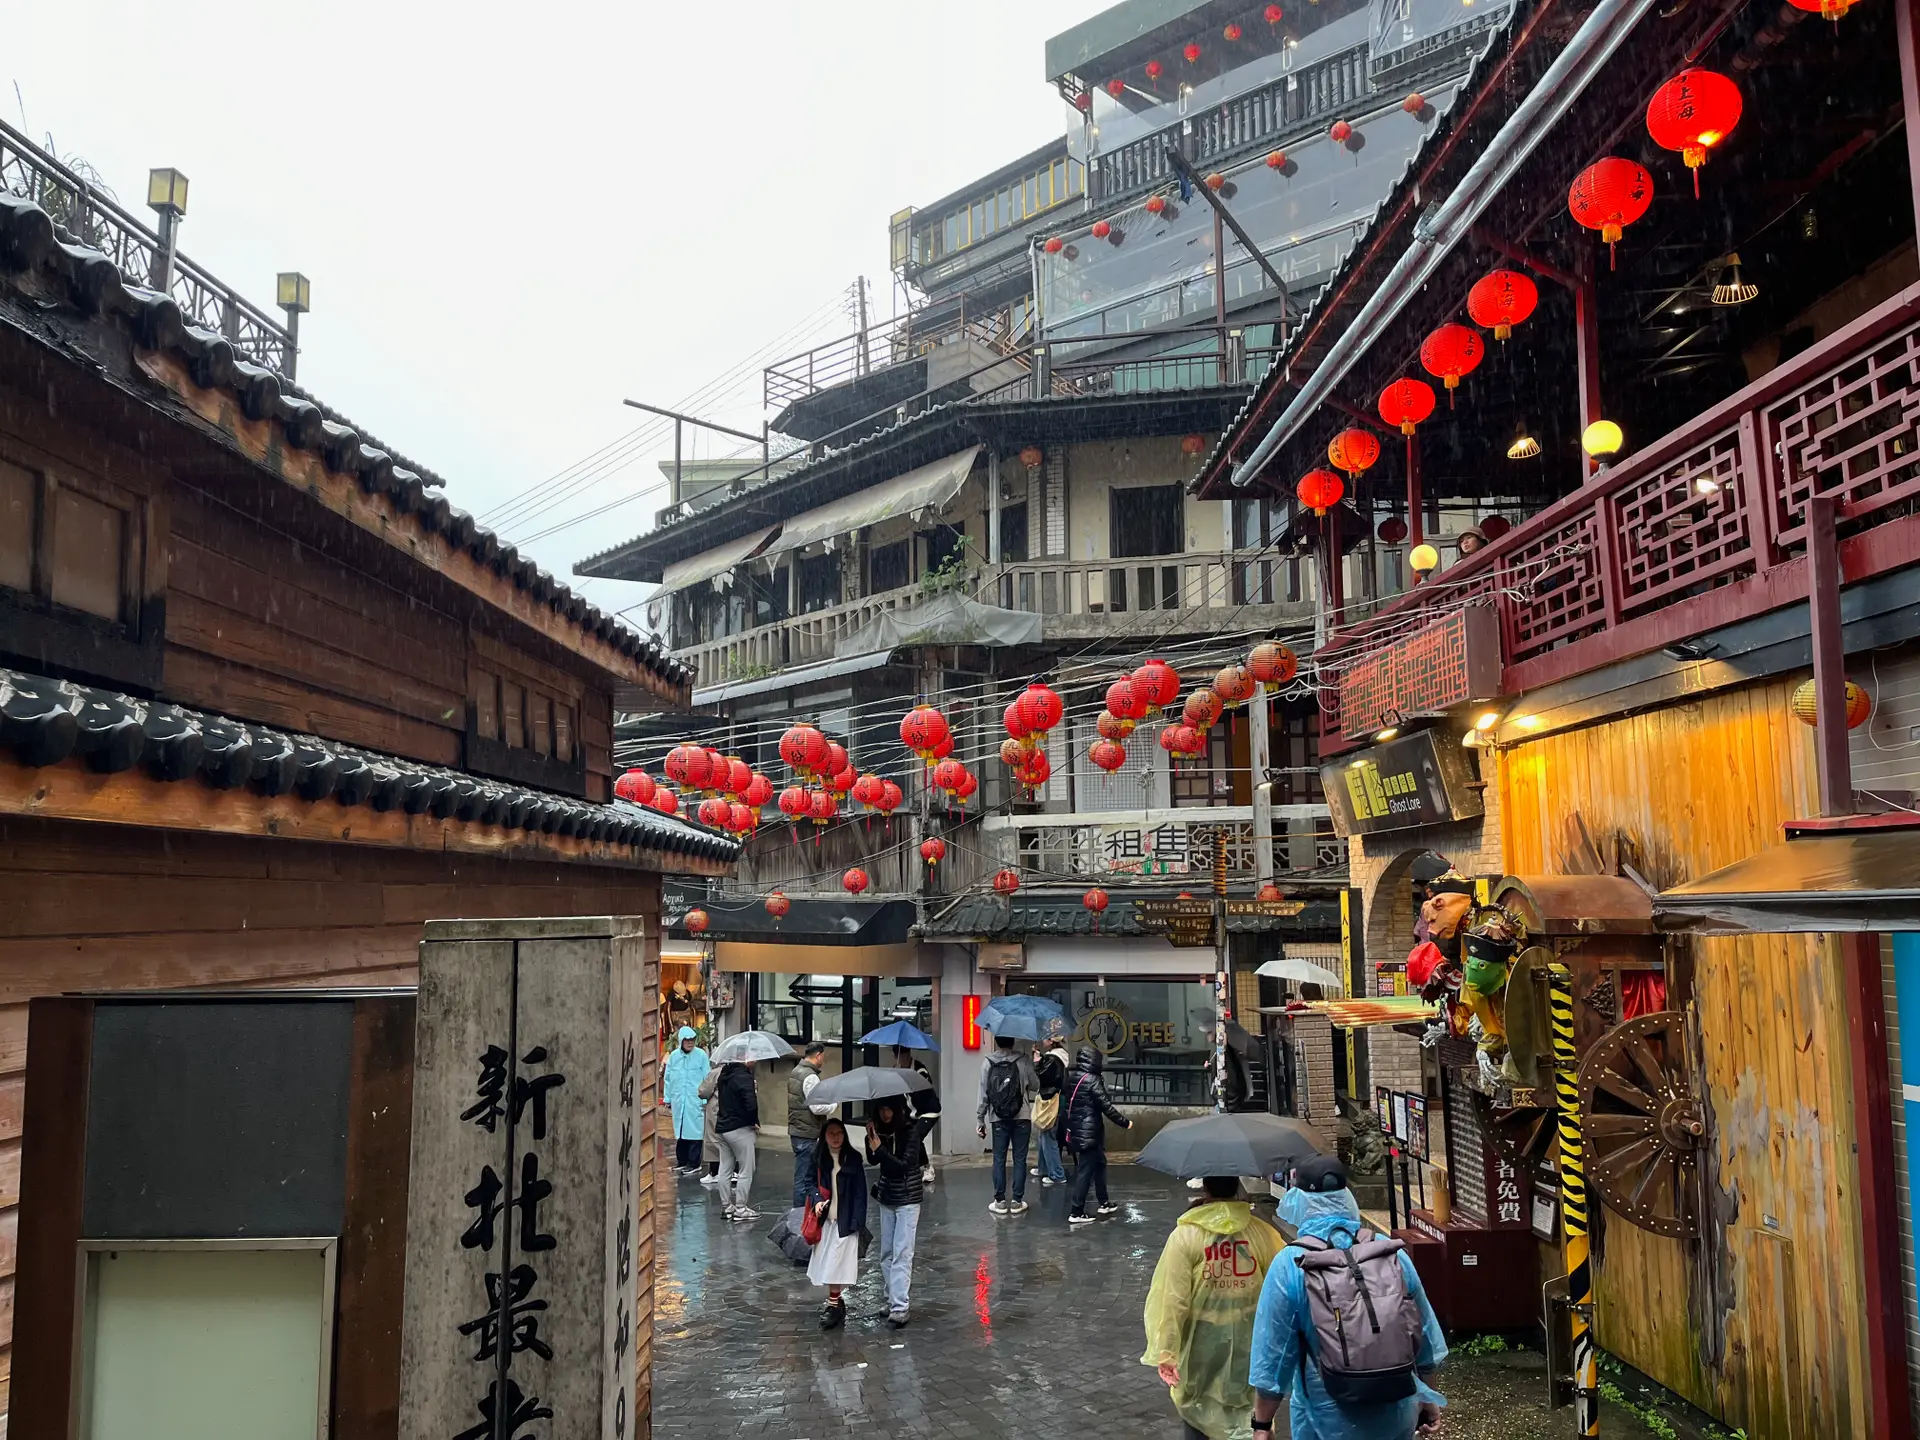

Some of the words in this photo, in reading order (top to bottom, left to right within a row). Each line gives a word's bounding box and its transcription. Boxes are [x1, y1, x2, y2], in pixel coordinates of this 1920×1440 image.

[1389, 800, 1407, 813] Ghost
[1407, 797, 1421, 811] Lore
[1105, 823, 1187, 862] 租售
[1202, 1260, 1232, 1280] BUS
[1213, 1280, 1246, 1289] TOURS
